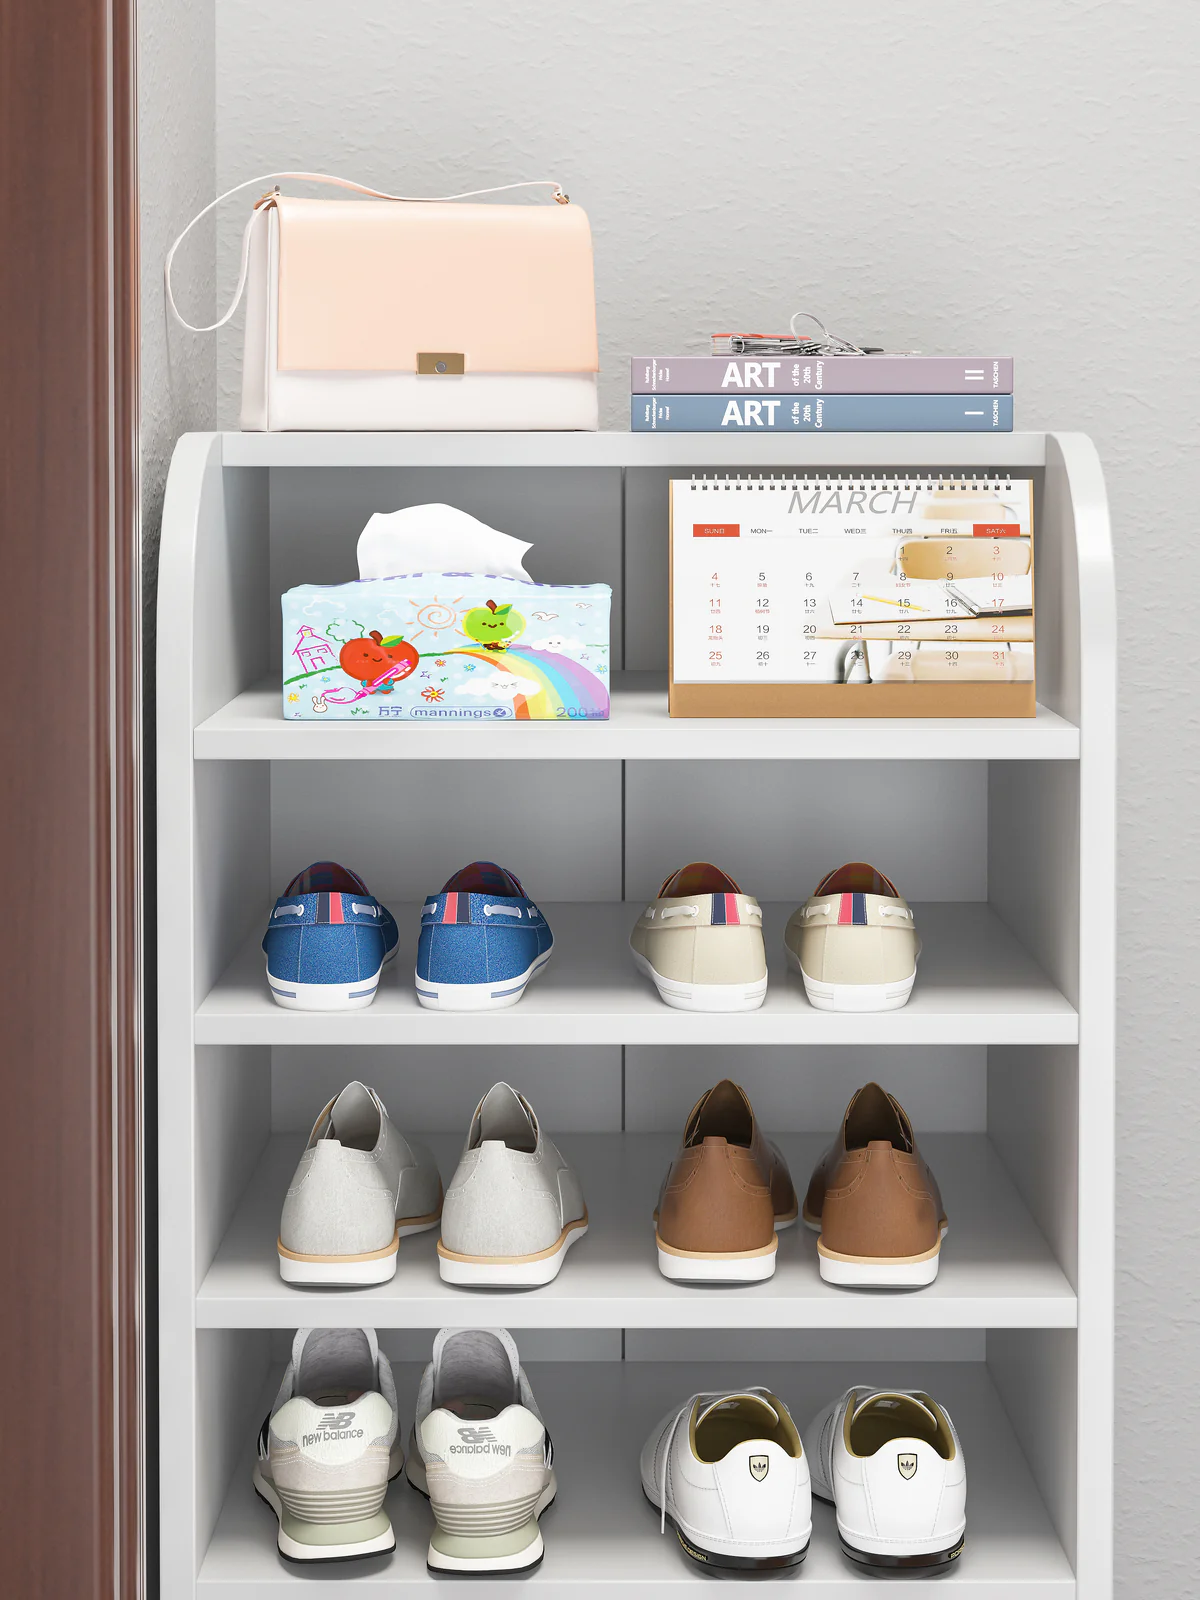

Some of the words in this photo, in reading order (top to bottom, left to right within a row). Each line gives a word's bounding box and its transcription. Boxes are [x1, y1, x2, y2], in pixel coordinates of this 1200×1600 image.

[720, 362, 780, 388] ART
[792, 364, 800, 376] the
[803, 366, 811, 384] 20th
[815, 360, 824, 390] Century
[792, 378, 800, 386] of
[720, 400, 780, 426] ART
[792, 402, 800, 414] the
[803, 404, 811, 422] 20th
[815, 398, 824, 428] Century
[792, 416, 800, 424] of
[788, 491, 918, 514] MARCH
[900, 546, 905, 554] 1
[946, 546, 953, 554] 2
[994, 546, 1000, 554] 3
[712, 572, 718, 581] 4
[759, 572, 765, 581] 5
[806, 572, 812, 581] 6
[853, 572, 859, 581] 7
[900, 572, 906, 581] 8
[946, 572, 953, 581] 9
[992, 572, 1004, 581] 10
[710, 599, 720, 607] 11
[756, 599, 769, 607] 12
[804, 599, 816, 607] 13
[851, 599, 862, 607] 14
[898, 599, 910, 607] 15
[945, 599, 957, 607] 16
[992, 599, 1004, 607] 17
[709, 625, 722, 633] 18
[757, 625, 769, 633] 19
[803, 625, 816, 633] 20
[850, 625, 862, 633] 21
[898, 625, 910, 633] 22
[945, 625, 958, 633] 23
[992, 625, 1004, 633] 24
[709, 651, 722, 660] 25
[756, 651, 770, 660] 26
[804, 651, 816, 660] 27
[851, 651, 864, 660] 28
[898, 651, 911, 660] 29
[945, 651, 958, 660] 30
[993, 651, 1005, 660] 31
[414, 708, 490, 718] mannings
[556, 707, 588, 717] 200
[302, 1432, 322, 1447] new
[324, 1428, 364, 1441] balance
